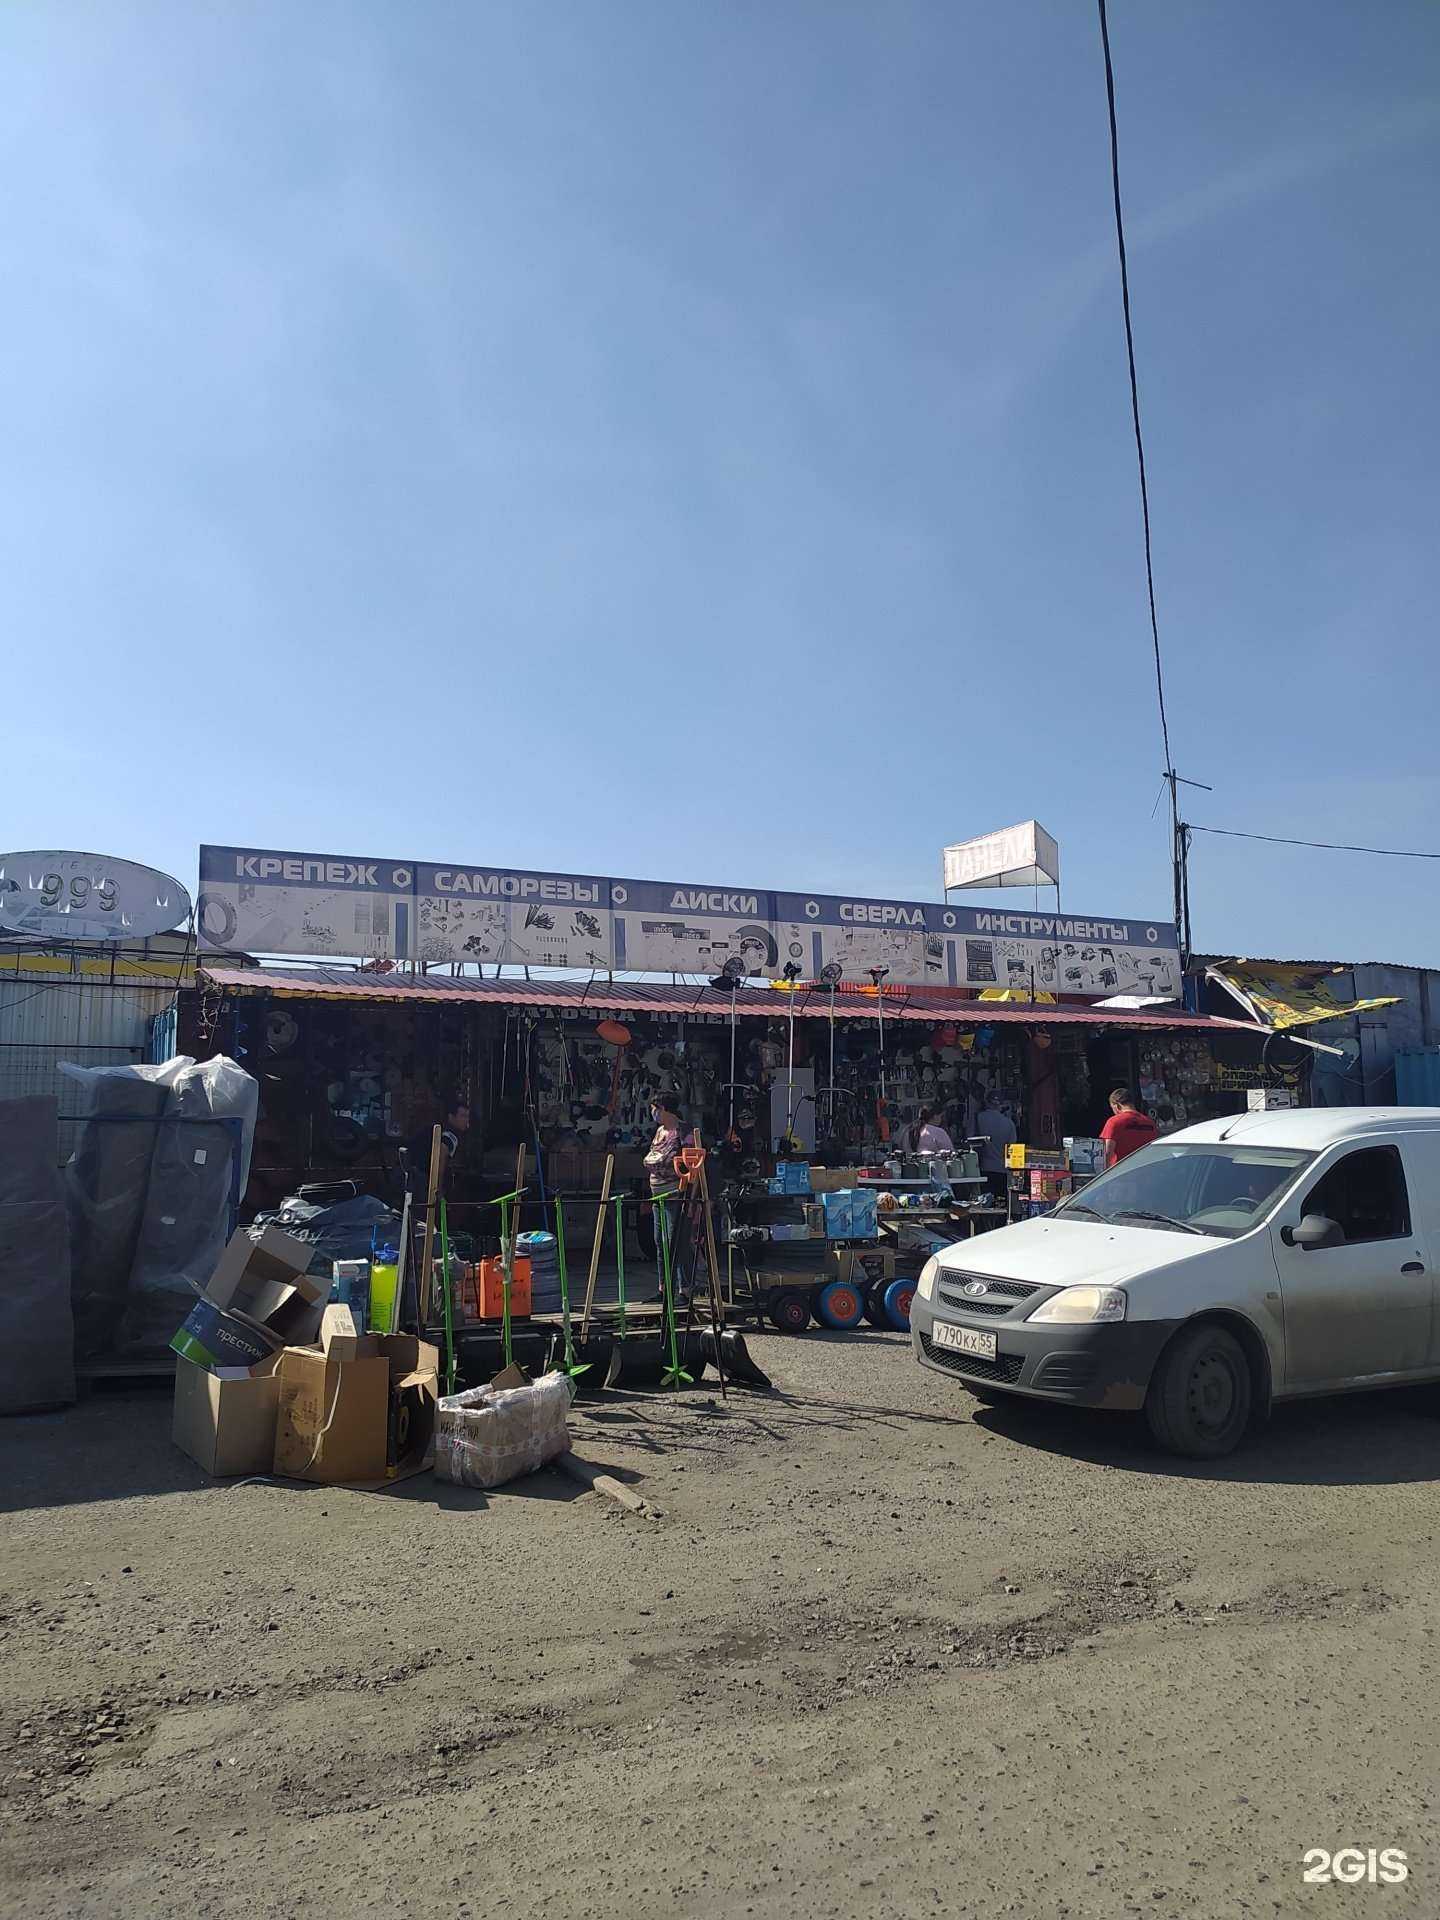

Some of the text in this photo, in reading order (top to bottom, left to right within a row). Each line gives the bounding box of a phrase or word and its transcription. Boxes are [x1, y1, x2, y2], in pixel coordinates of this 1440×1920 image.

[235, 855, 379, 886] КРЕПЕЖ
[40, 873, 120, 911] 999
[433, 871, 599, 902] САМОРЕЗЫ
[670, 889, 758, 914] ДИСКИ
[839, 903, 925, 926] СВЕРЛА
[975, 913, 1129, 941] ИНСТРУМЕНТЫ
[980, 1333, 993, 1349] 55
